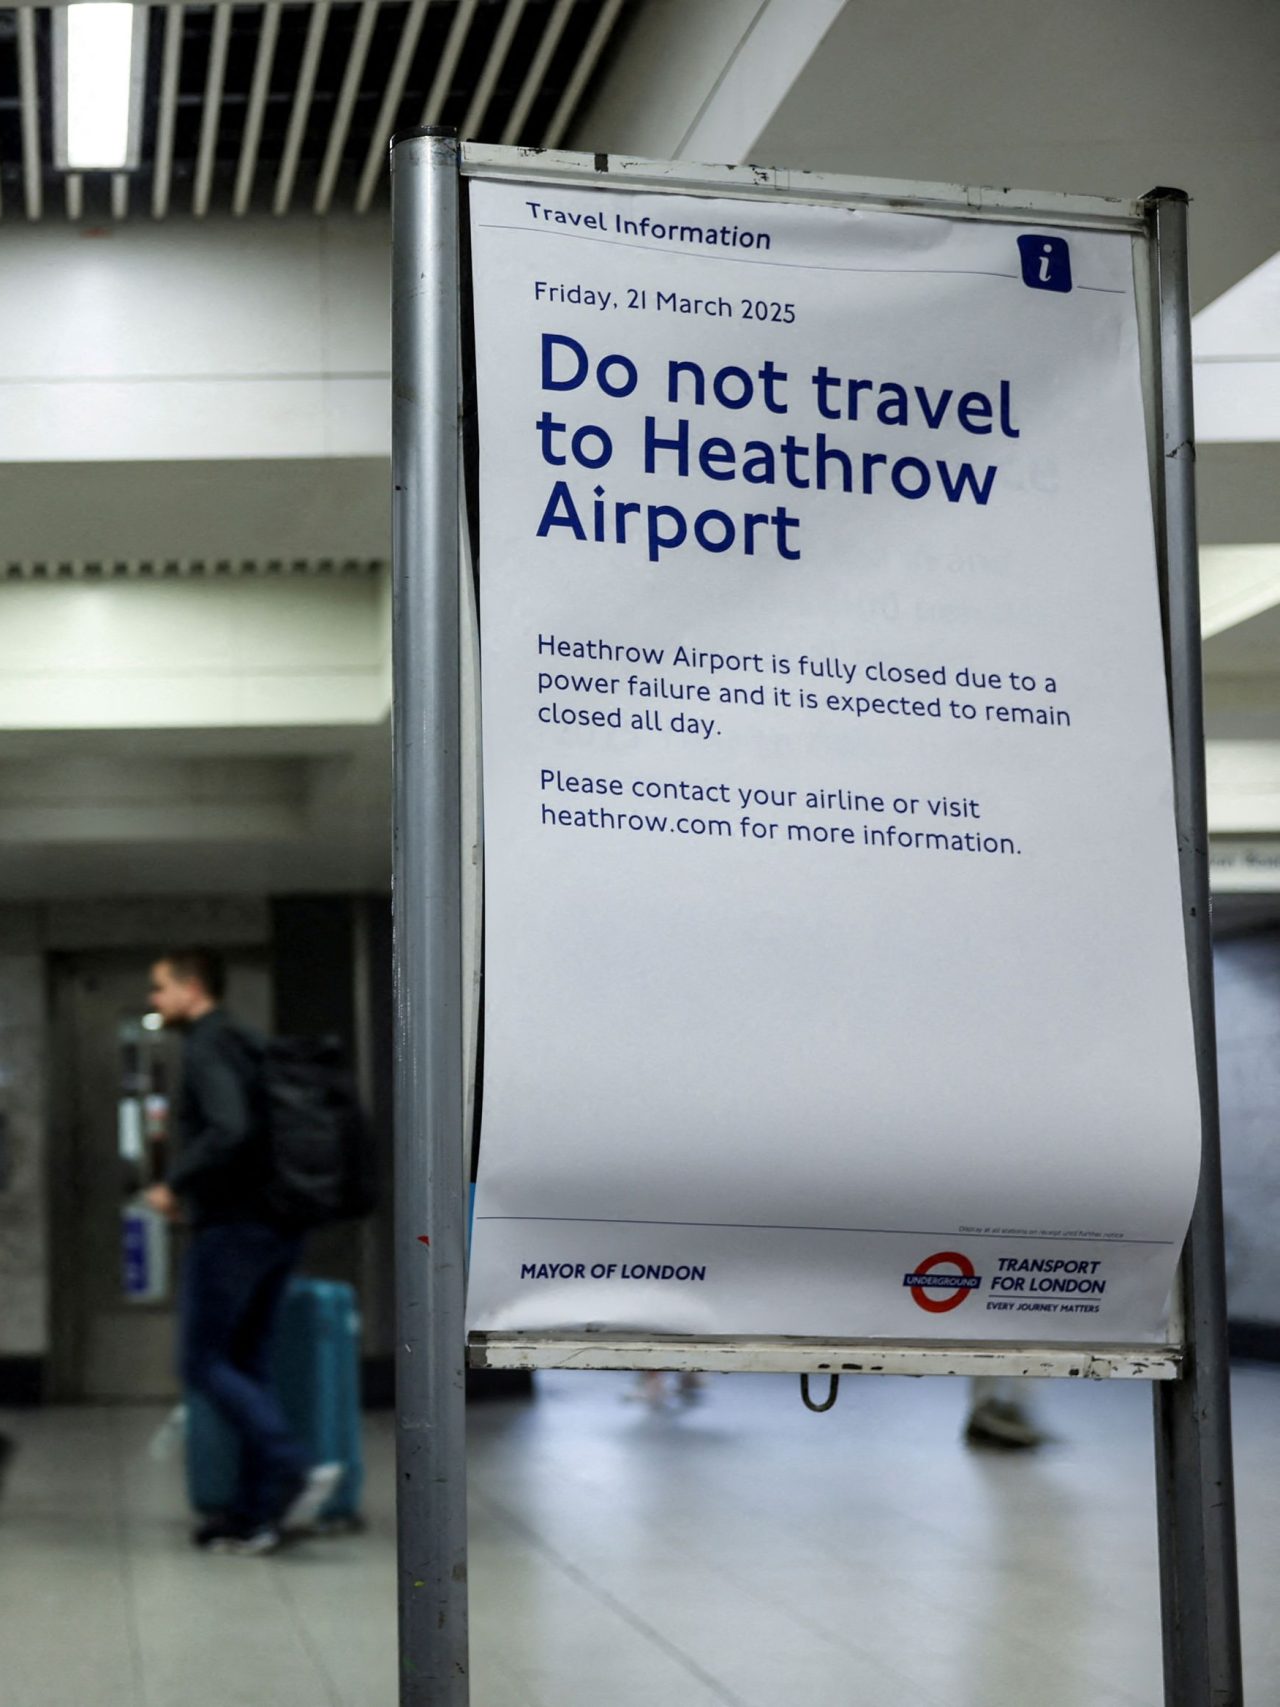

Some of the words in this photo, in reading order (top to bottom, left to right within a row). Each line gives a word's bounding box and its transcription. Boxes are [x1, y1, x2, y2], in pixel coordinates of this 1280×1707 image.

[525, 201, 608, 232] Travel
[615, 214, 771, 250] Information
[534, 281, 618, 311] Friday,
[627, 288, 646, 310] 21
[656, 291, 732, 318] March
[741, 299, 796, 324] 2025
[541, 332, 638, 398] Do
[668, 360, 788, 415] not
[811, 366, 1020, 439] travel
[535, 411, 613, 470] to
[644, 415, 998, 506] Heathrow
[535, 480, 801, 563] Airport
[538, 633, 665, 665] Heathrow
[672, 645, 764, 675] Airport
[772, 654, 791, 675] is
[798, 655, 857, 685] fully
[865, 661, 947, 686] closed
[955, 667, 1002, 690] due
[1008, 672, 1036, 692] to
[1044, 677, 1057, 694] a
[538, 672, 620, 695] power
[627, 674, 711, 702] failure
[719, 685, 765, 706] and
[773, 686, 792, 708] it
[799, 688, 818, 709] is
[826, 694, 942, 718] expected
[948, 700, 977, 720] to
[985, 705, 1071, 727] remain
[538, 702, 622, 729] closed
[631, 709, 663, 732] all
[670, 712, 721, 740] day.
[540, 769, 623, 796] Please
[631, 781, 731, 803] contact
[738, 788, 798, 809] your
[805, 789, 885, 813] airline
[892, 797, 920, 815] or
[927, 796, 981, 819] visit
[541, 803, 732, 837] heathrow.com
[739, 816, 779, 839] for
[787, 824, 855, 844] more
[863, 824, 1022, 855] information.
[520, 1263, 586, 1279] MAYOR
[590, 1263, 618, 1279] OF
[621, 1264, 707, 1281] LONDON
[906, 1276, 978, 1287] UNDERGROUND
[990, 1276, 1025, 1291] FOR
[1029, 1277, 1106, 1294] LONDON
[997, 1257, 1101, 1274] TRANSPORT
[986, 1301, 1015, 1311] EVERY
[1016, 1302, 1059, 1313] JOURNEY
[1059, 1304, 1100, 1313] MATTERS
